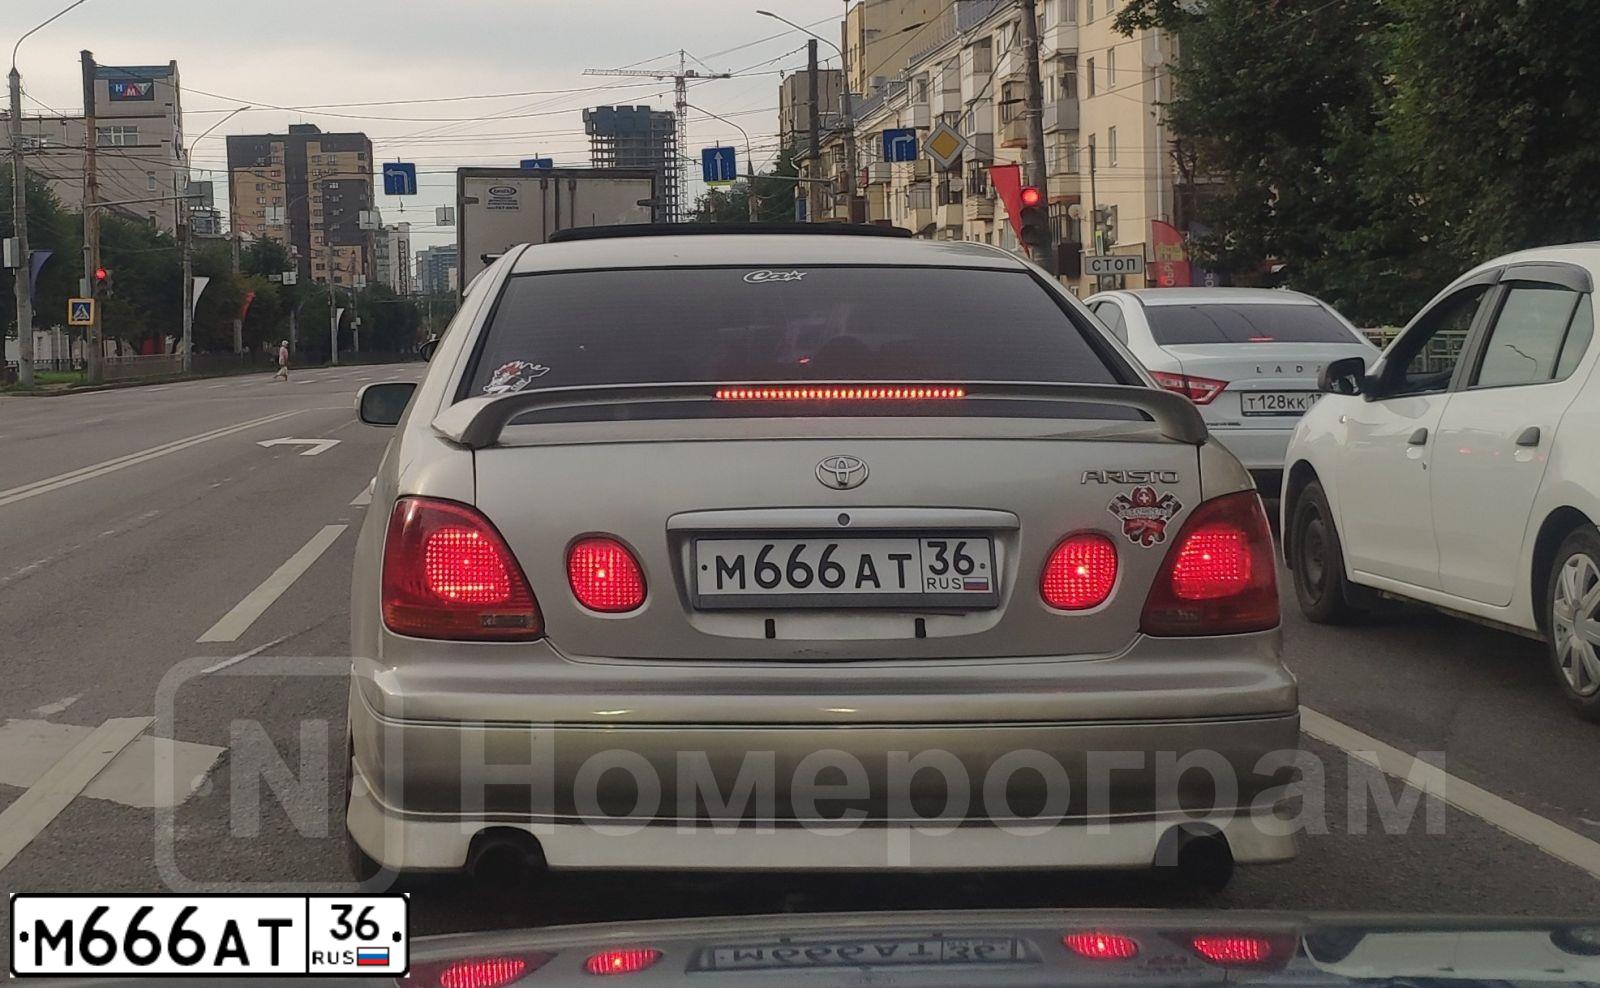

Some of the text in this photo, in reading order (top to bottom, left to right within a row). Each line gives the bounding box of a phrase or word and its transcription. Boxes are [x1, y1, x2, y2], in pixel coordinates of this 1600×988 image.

[1091, 258, 1136, 272] СТОП
[1080, 470, 1180, 484] ARISTO
[927, 541, 975, 576] 36
[926, 577, 962, 591] RUS
